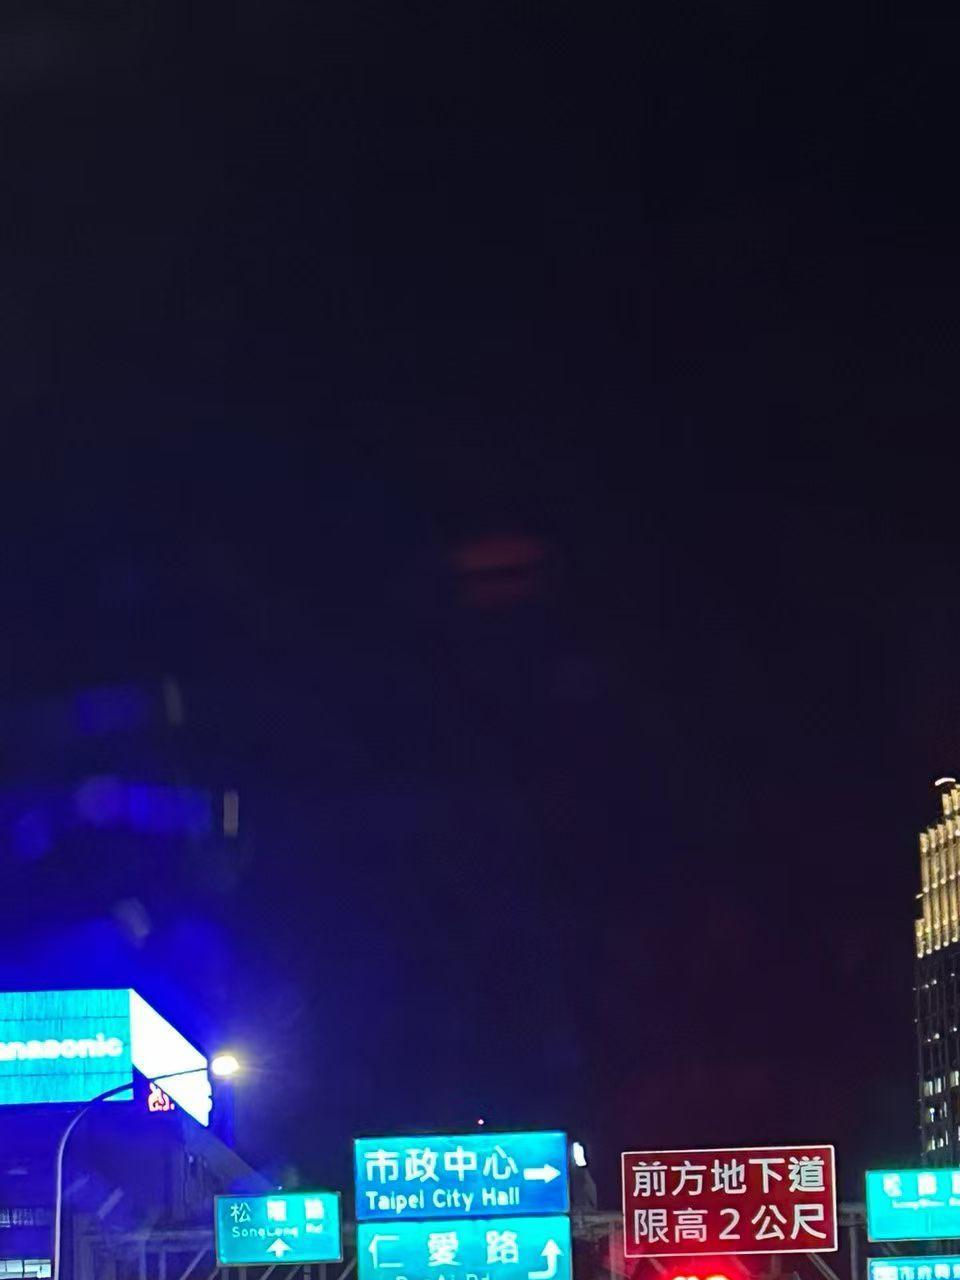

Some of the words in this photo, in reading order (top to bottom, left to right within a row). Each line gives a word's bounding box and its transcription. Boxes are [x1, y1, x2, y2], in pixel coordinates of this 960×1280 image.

[363, 1145, 519, 1184] 市政中心
[632, 1156, 826, 1197] 前方地下道
[366, 1189, 424, 1214] Taipei
[432, 1188, 475, 1212] City
[482, 1187, 520, 1206] Hall
[633, 1203, 828, 1245] 限高2公尺
[368, 1230, 520, 1270] 仁愛路
